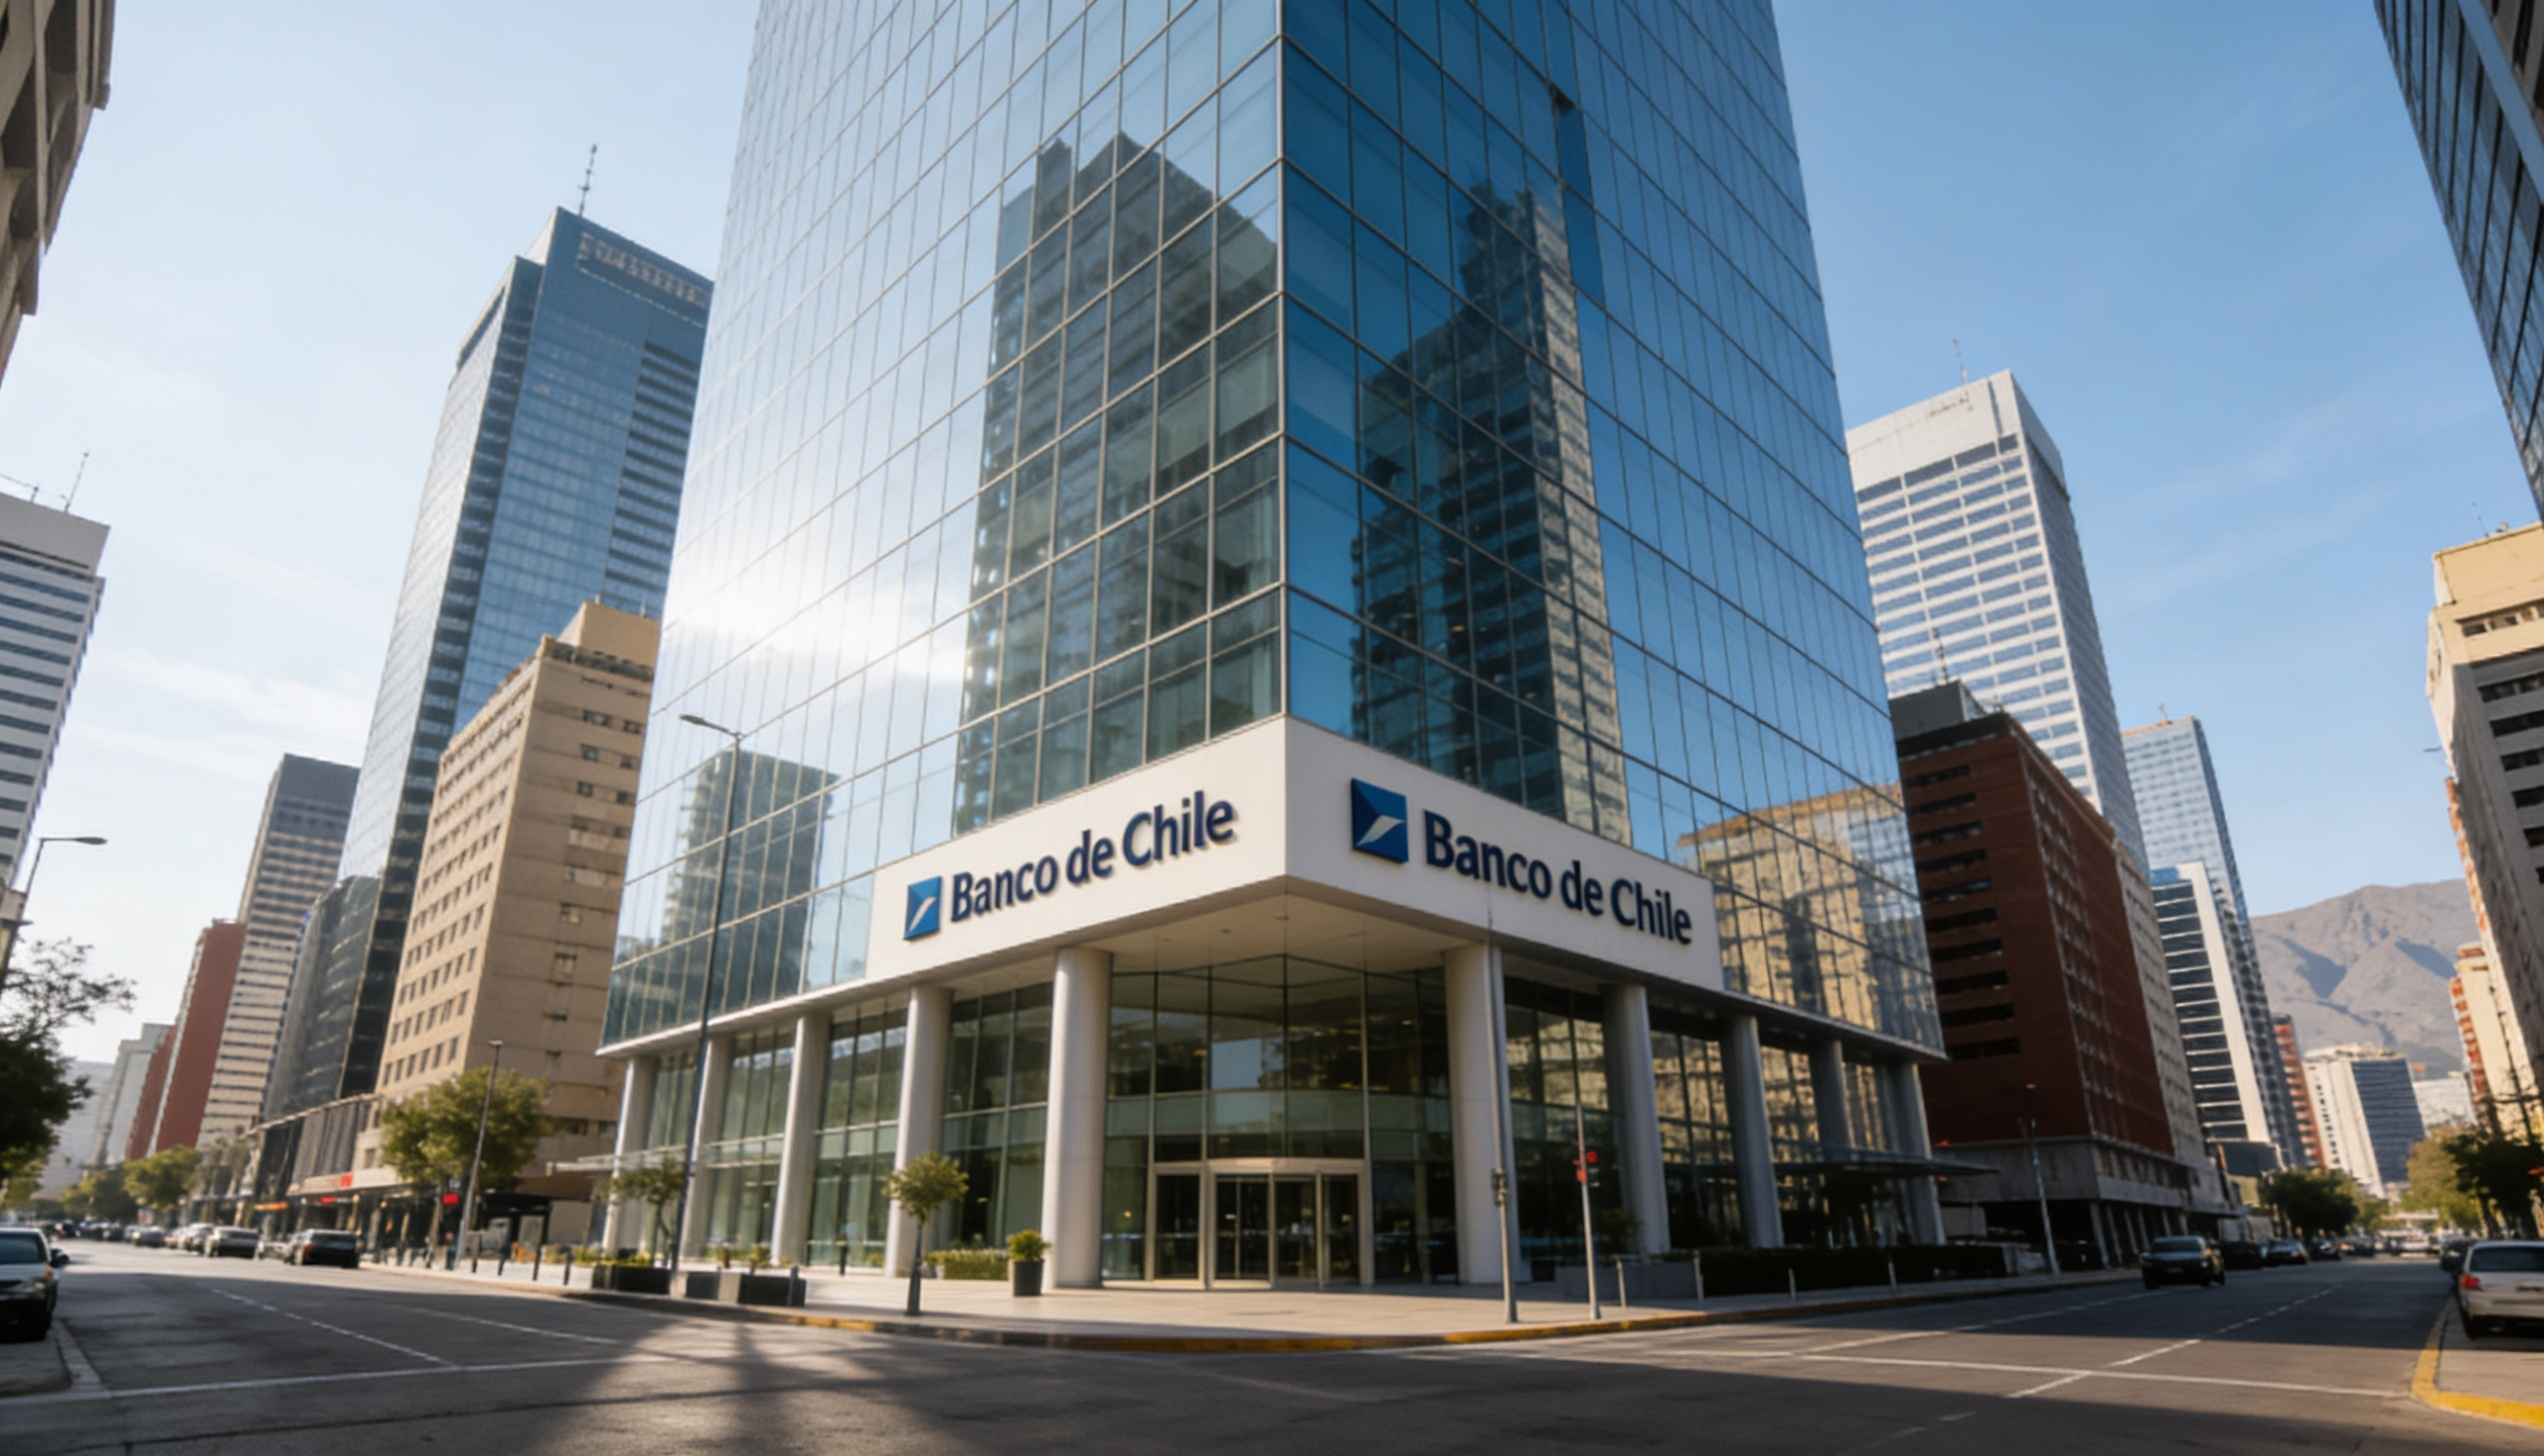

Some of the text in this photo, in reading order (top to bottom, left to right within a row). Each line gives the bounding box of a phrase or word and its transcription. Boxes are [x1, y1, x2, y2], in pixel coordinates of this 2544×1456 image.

[951, 790, 1236, 922] Banco de Chile
[1423, 809, 1693, 946] Banco de Chile
